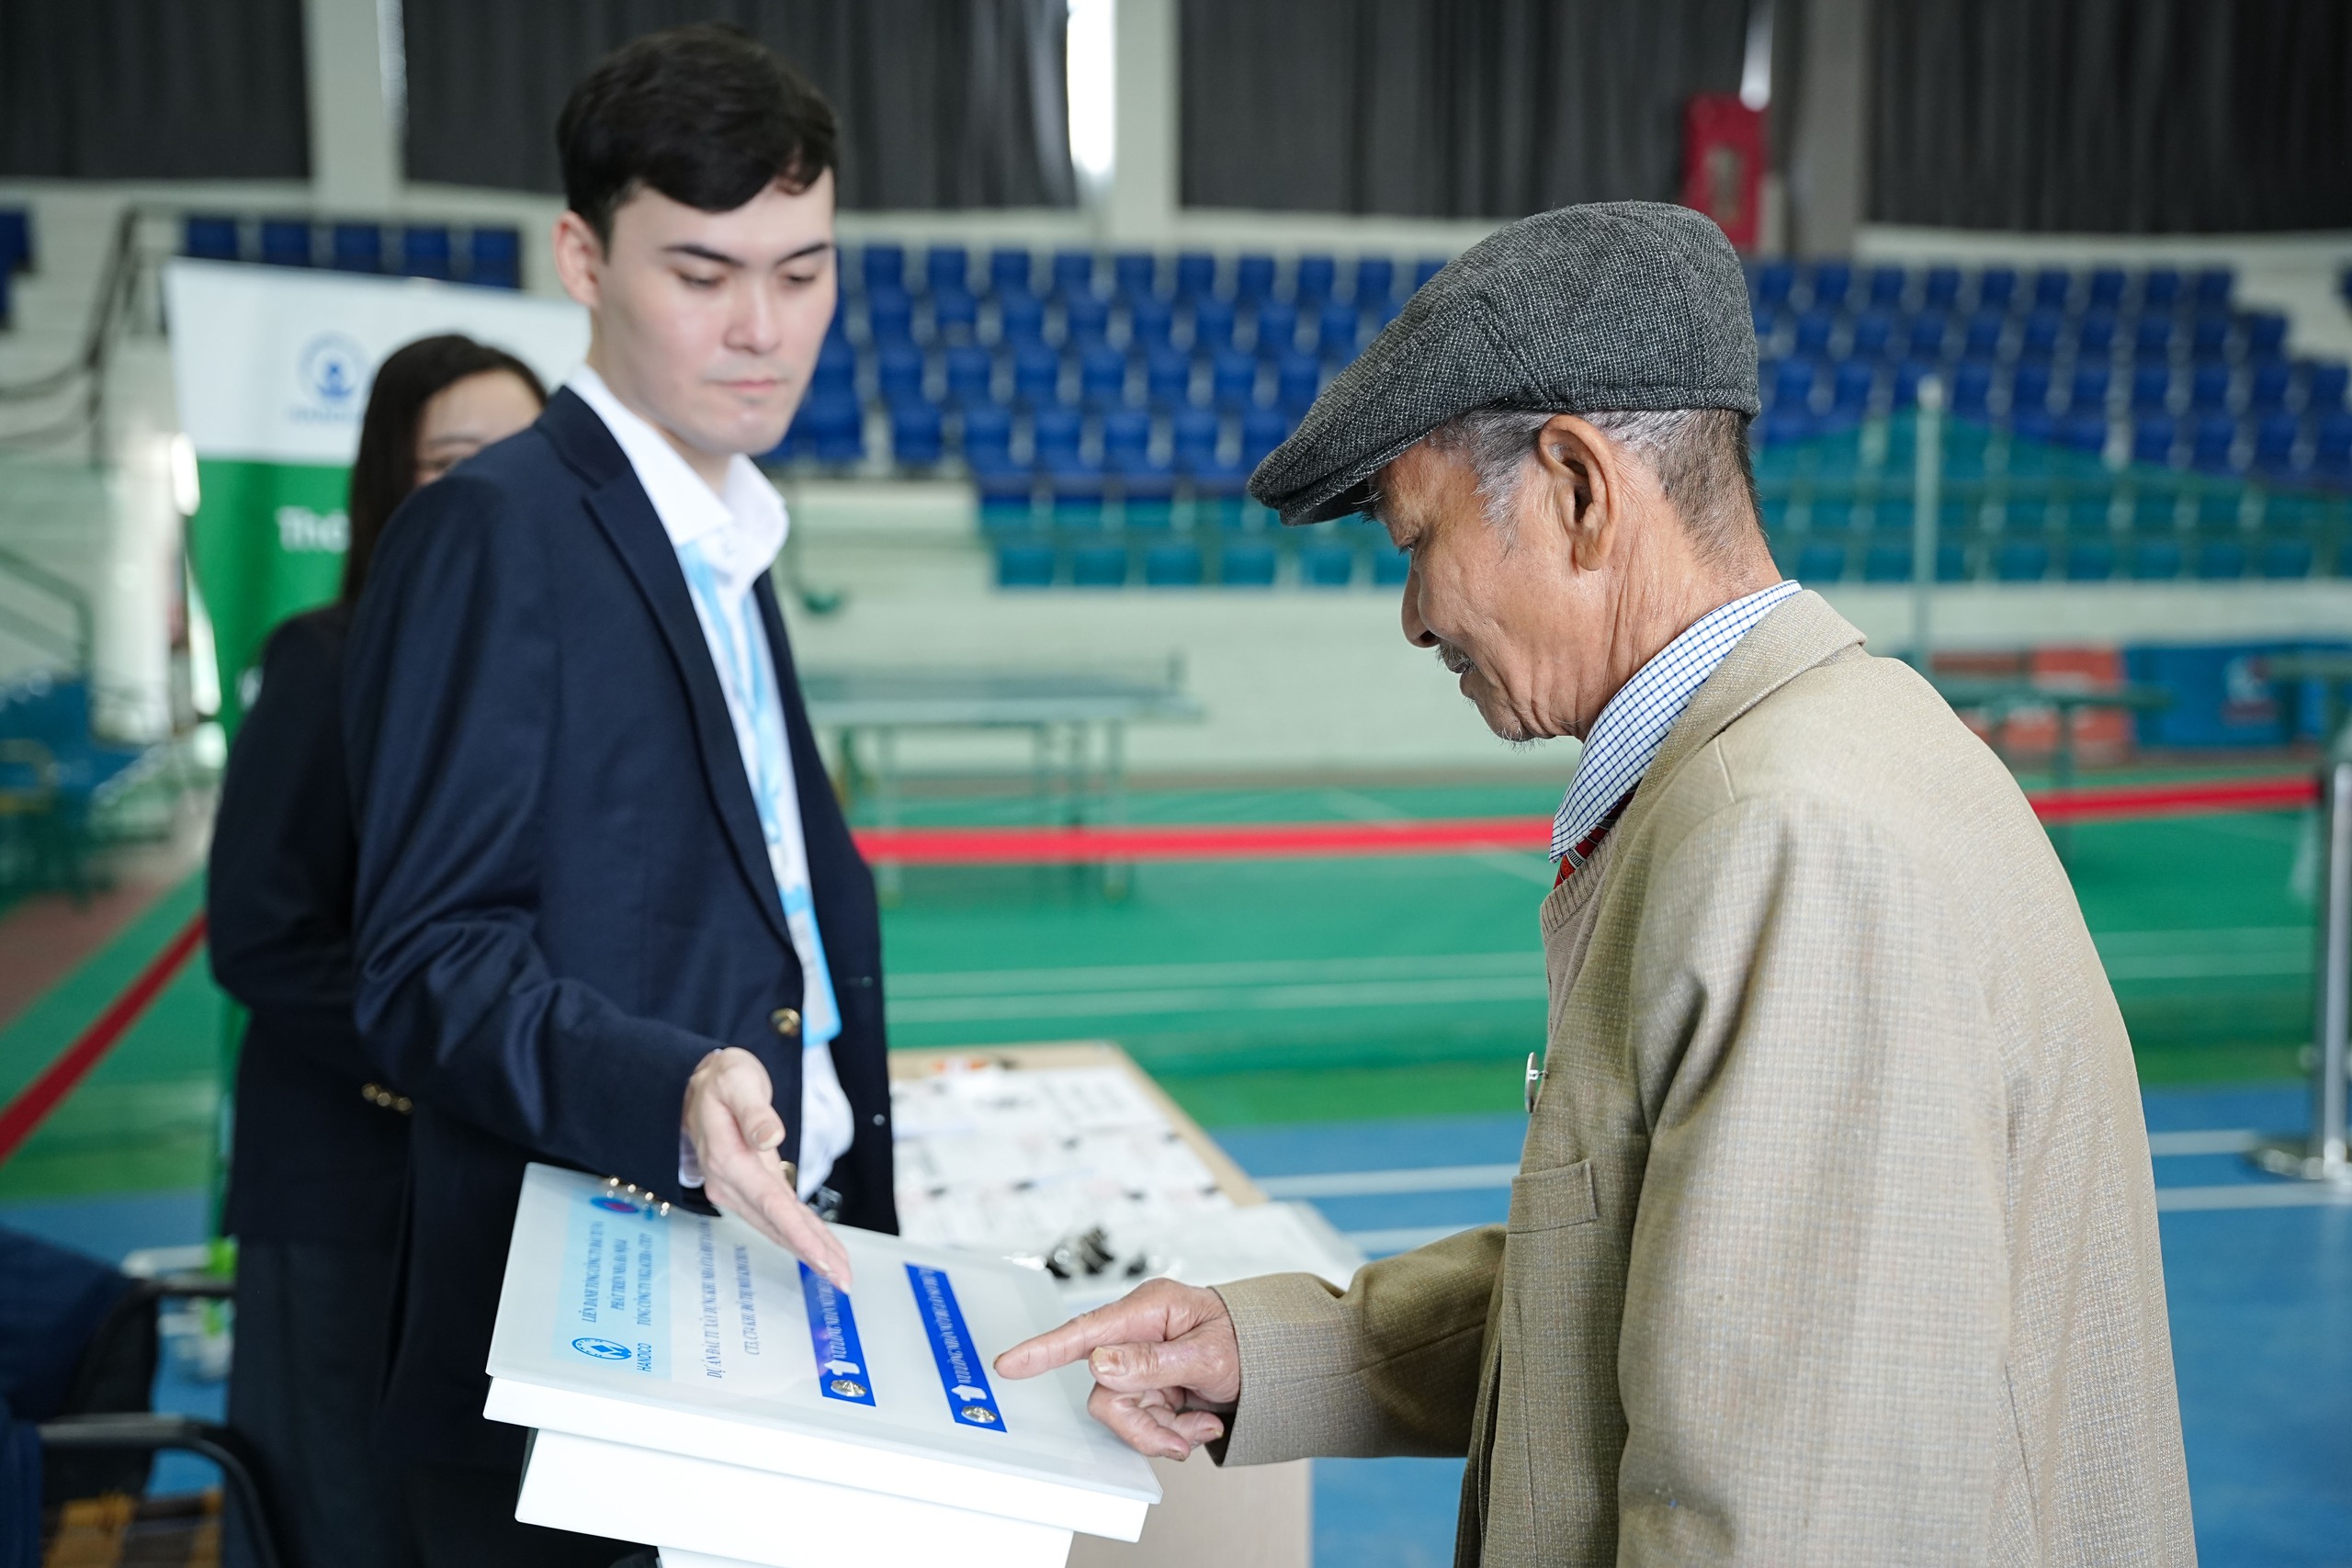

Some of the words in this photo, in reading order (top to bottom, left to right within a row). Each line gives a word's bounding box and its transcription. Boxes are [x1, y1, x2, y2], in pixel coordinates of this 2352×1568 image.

[577, 1305, 596, 1322] LIÊN
[636, 1342, 652, 1371] HANDICO
[700, 1355, 720, 1366] ÁN
[704, 1365, 726, 1378] DỰ
